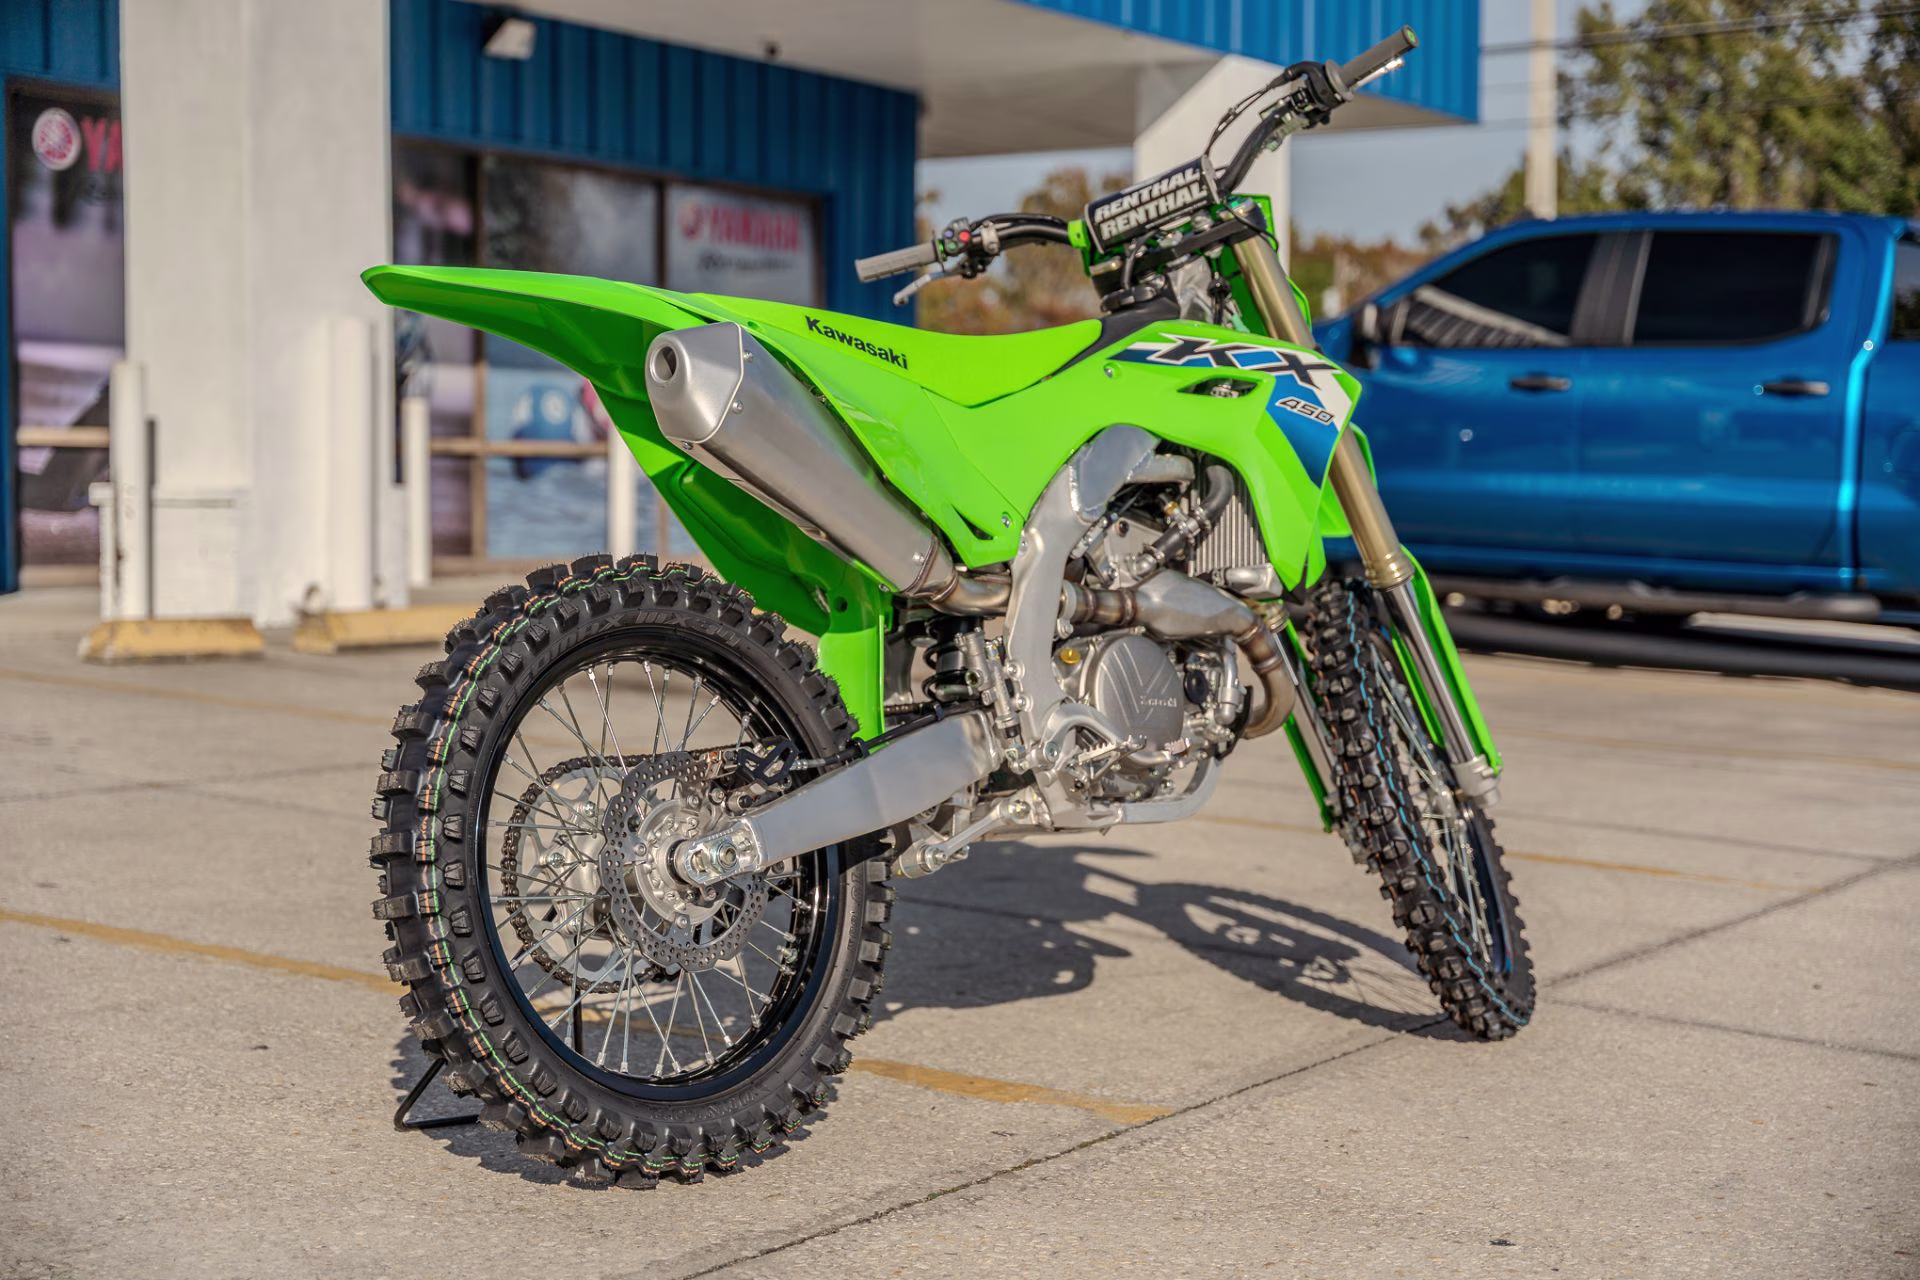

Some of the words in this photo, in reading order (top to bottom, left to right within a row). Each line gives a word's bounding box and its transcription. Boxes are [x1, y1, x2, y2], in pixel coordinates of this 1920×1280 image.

[1094, 167, 1200, 223] RENTHAL
[1101, 181, 1208, 241] RENTHAL
[805, 315, 908, 370] Kawasaki
[1276, 397, 1334, 426] 450
